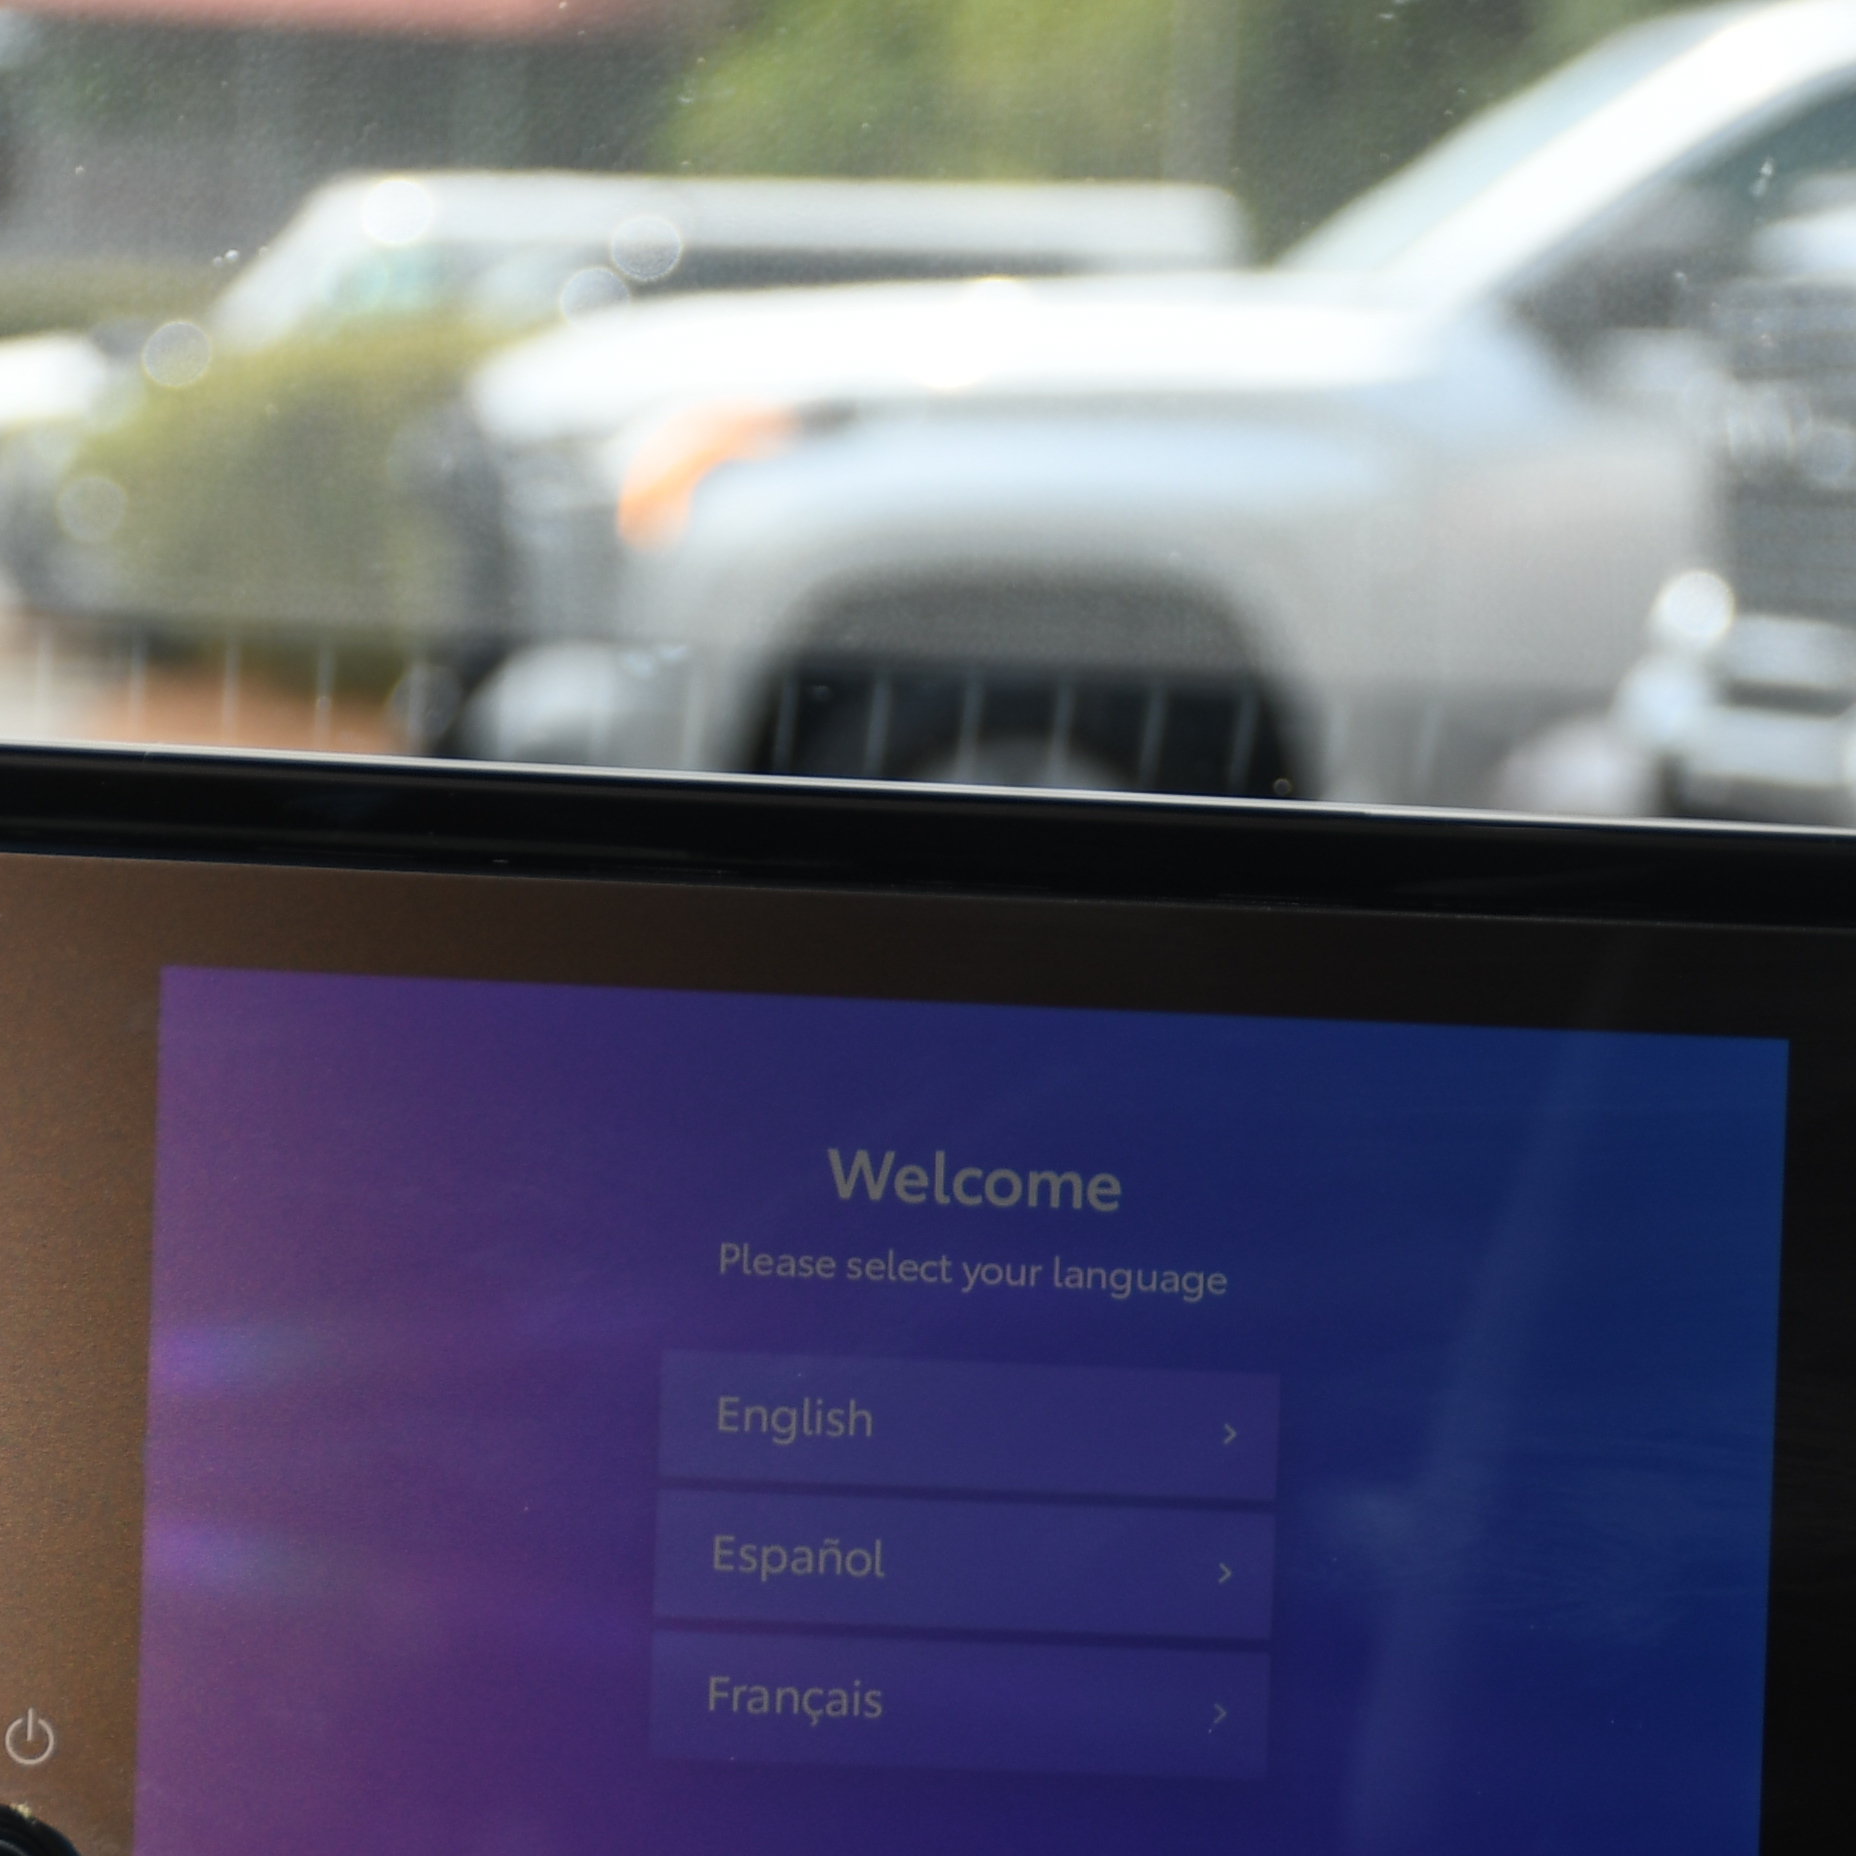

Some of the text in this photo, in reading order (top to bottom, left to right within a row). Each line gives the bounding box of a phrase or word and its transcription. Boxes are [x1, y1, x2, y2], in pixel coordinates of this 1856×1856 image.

[827, 1147, 1123, 1212] Welcome
[718, 1243, 1229, 1303] Please select your language
[717, 1396, 874, 1446] English
[713, 1535, 886, 1582] Español
[707, 1675, 884, 1726] Français
